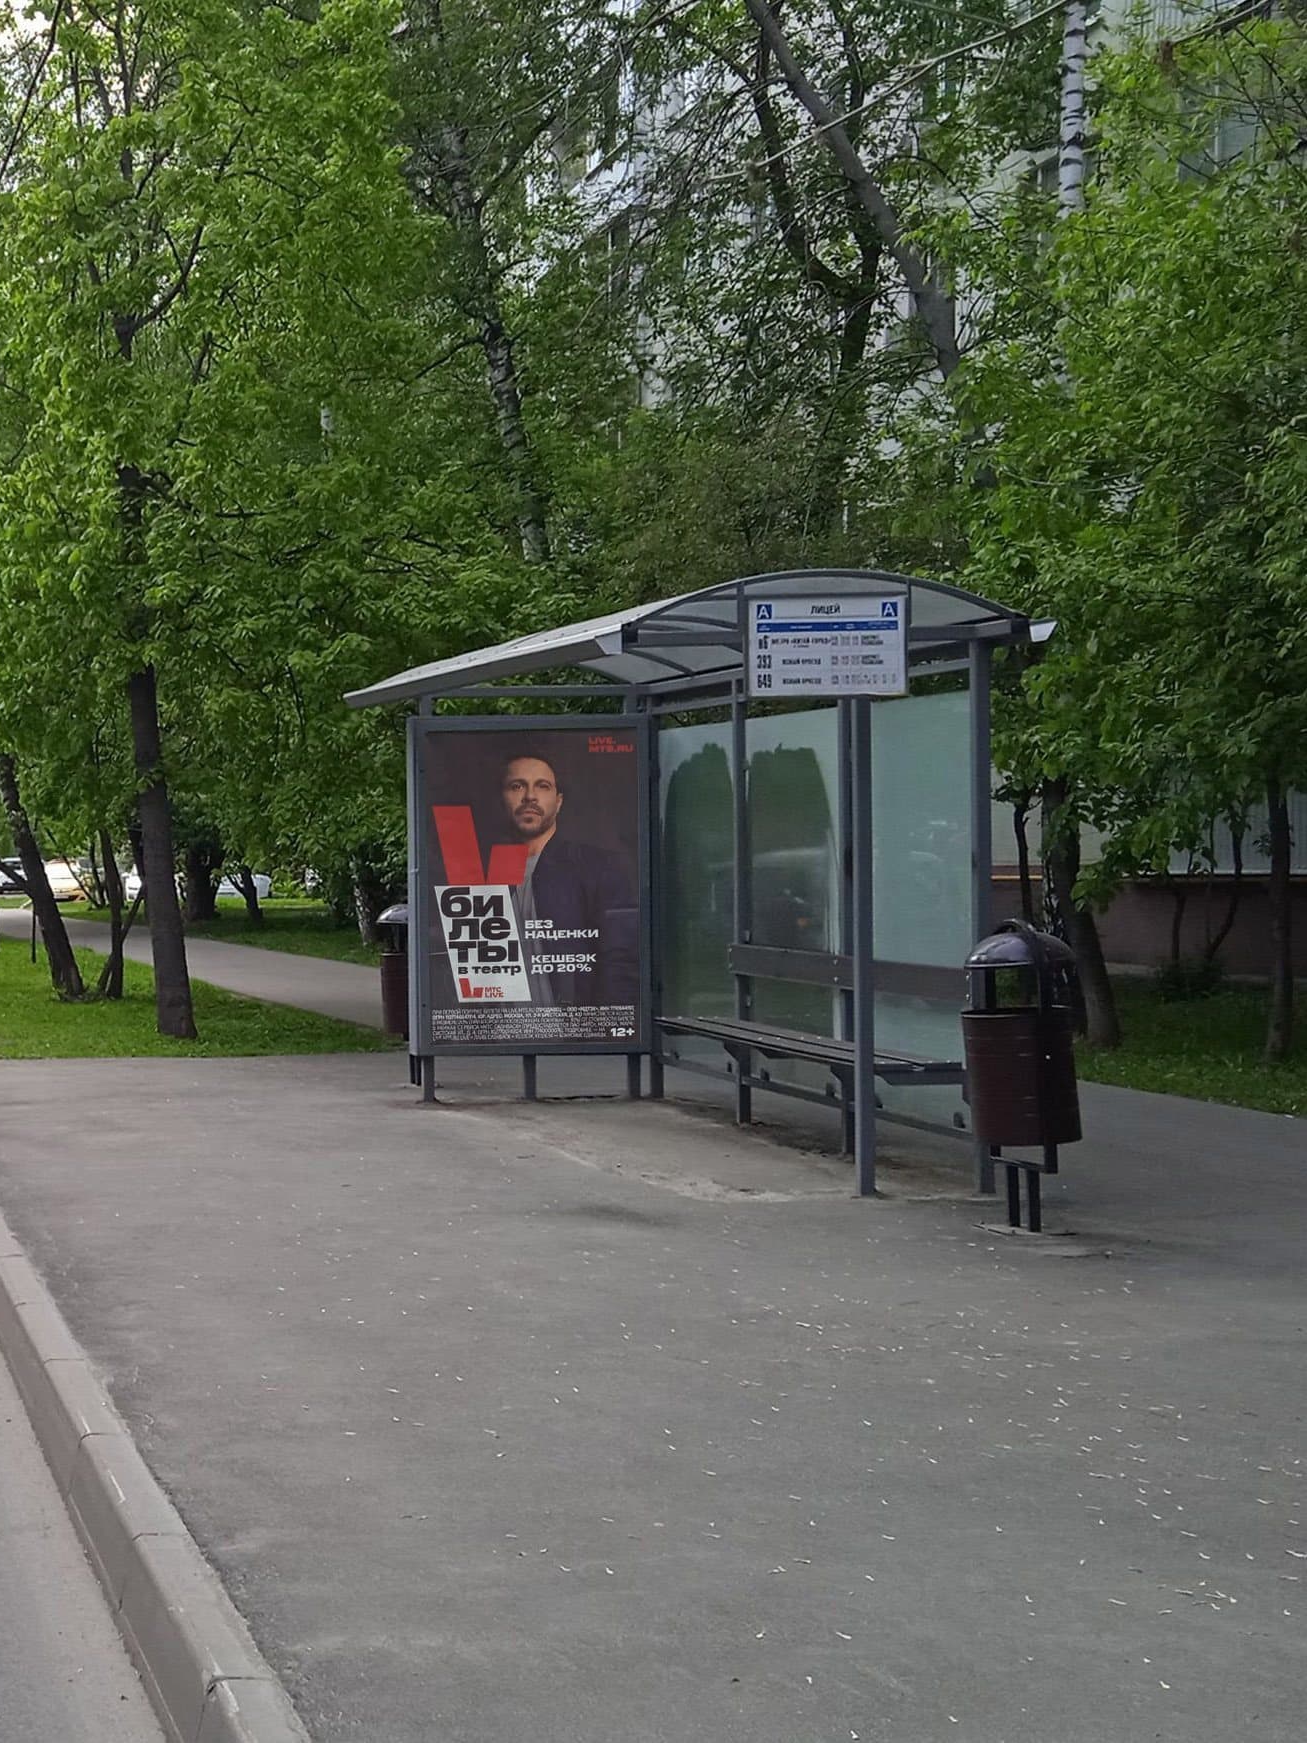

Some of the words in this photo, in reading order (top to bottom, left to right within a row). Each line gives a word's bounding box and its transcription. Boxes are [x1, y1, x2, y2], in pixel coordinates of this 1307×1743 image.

[811, 603, 841, 615] ЛИЦЕЙ
[756, 655, 772, 669] 393
[757, 674, 772, 688] 649
[524, 919, 554, 930] БЕЗ
[524, 929, 600, 941] НАЦЕНКИ
[531, 953, 597, 964] КЕШБЭК
[458, 966, 469, 975] в
[472, 965, 522, 976] театр
[531, 964, 555, 975] ДО
[557, 963, 592, 973] 20%
[610, 1027, 635, 1037] 12+
